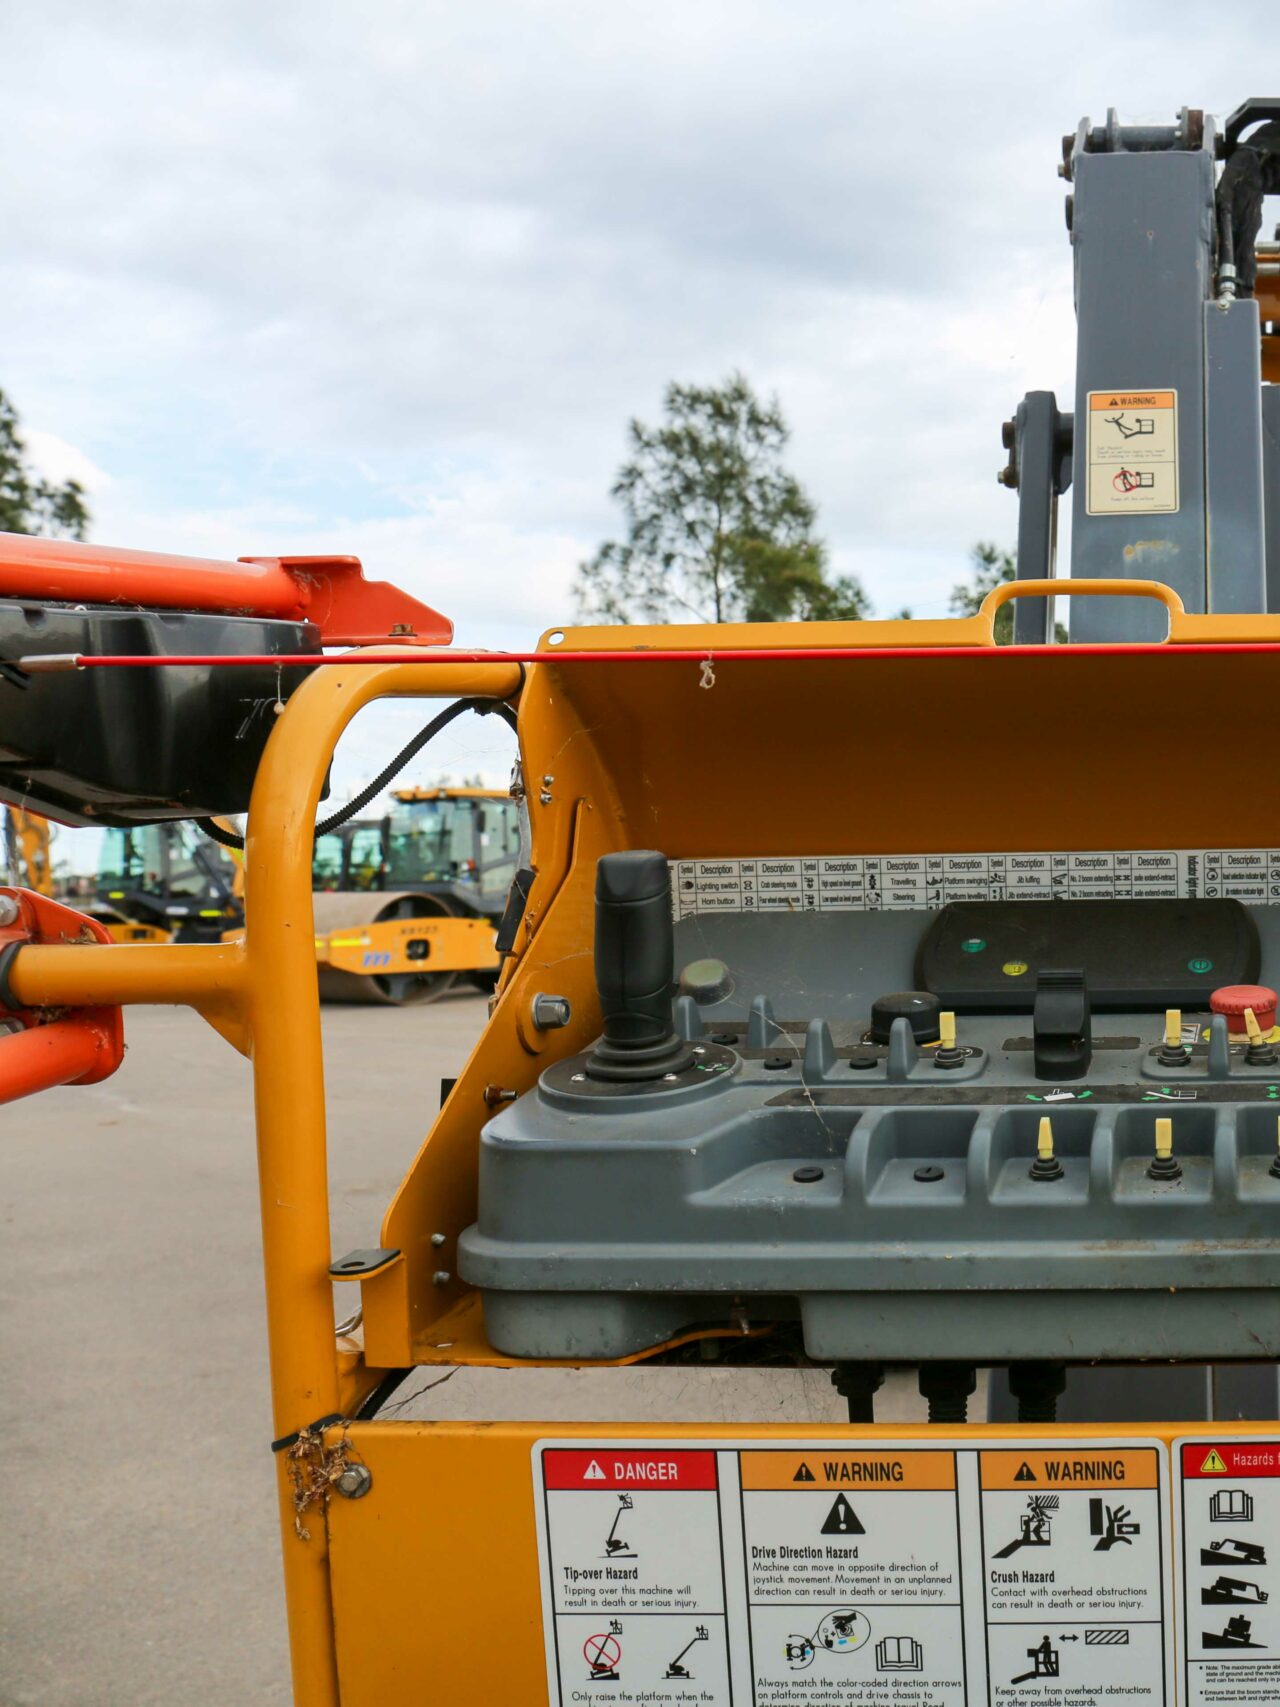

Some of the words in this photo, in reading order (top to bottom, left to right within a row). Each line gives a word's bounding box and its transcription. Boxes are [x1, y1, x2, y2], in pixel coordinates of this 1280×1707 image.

[1120, 397, 1156, 405] WARNING
[950, 860, 982, 869] Description
[1012, 858, 1044, 868] Description
[1075, 857, 1108, 867] Description
[1138, 857, 1170, 866] Description
[1228, 856, 1260, 865] Description
[701, 865, 732, 875] Description
[762, 864, 794, 874] Description
[825, 862, 857, 872] Description
[887, 861, 919, 871] Description
[697, 882, 719, 891] Lighting
[893, 893, 915, 902] Steering
[1233, 1453, 1274, 1465] Hazards
[614, 1463, 678, 1480] DANGER
[823, 1462, 903, 1481] WARNING
[1045, 1460, 1125, 1481] WARNING
[752, 1546, 776, 1558] Drive
[780, 1546, 822, 1558] Direction
[826, 1546, 858, 1558] Hazard
[753, 1562, 789, 1571] Machine
[838, 1563, 844, 1571] in
[848, 1562, 885, 1574] opposite
[889, 1562, 926, 1571] direction
[930, 1562, 939, 1571] of
[564, 1567, 602, 1582] Tip-over
[606, 1567, 638, 1580] Hazard
[991, 1571, 1018, 1583] Crush
[1022, 1571, 1055, 1583] Hazard
[753, 1575, 784, 1585] joystick
[835, 1575, 880, 1584] Movement
[884, 1575, 891, 1583] in
[909, 1575, 951, 1585] unplanned
[564, 1585, 595, 1596] Tipping
[622, 1585, 635, 1594] this
[639, 1585, 673, 1594] machine
[677, 1585, 691, 1594] will
[754, 1587, 791, 1596] direction
[813, 1587, 836, 1596] result
[840, 1587, 846, 1596] in
[850, 1587, 875, 1596] death
[891, 1587, 917, 1596] seriou
[921, 1587, 946, 1598] injury.
[991, 1587, 1026, 1596] Contact
[1030, 1587, 1048, 1596] with
[1052, 1586, 1092, 1596] overhead
[1096, 1587, 1147, 1596] obstructions
[565, 1598, 586, 1606] result
[602, 1598, 626, 1606] death
[642, 1598, 671, 1606] serious
[675, 1598, 699, 1608] injury.
[1011, 1600, 1033, 1608] result
[1037, 1600, 1044, 1608] in
[1048, 1599, 1072, 1608] death
[1089, 1599, 1115, 1608] seriou
[1119, 1599, 1144, 1609] injury.
[758, 1678, 788, 1688] Always
[792, 1678, 817, 1687] match
[820, 1678, 833, 1687] the
[837, 1678, 887, 1687] color-coded
[891, 1678, 928, 1687] direction
[771, 1690, 807, 1701] platform
[811, 1690, 844, 1699] controls
[847, 1690, 863, 1699] and
[866, 1689, 889, 1699] drive
[892, 1690, 921, 1699] chassis
[924, 1690, 933, 1699] to
[995, 1686, 1015, 1696] Keep
[1045, 1686, 1062, 1695] from
[1065, 1685, 1103, 1695] overhead
[1105, 1686, 1151, 1694] obstructions
[572, 1691, 592, 1703] Only
[620, 1691, 632, 1701] the
[636, 1692, 672, 1702] platform
[676, 1691, 697, 1701] when
[701, 1691, 714, 1701] the
[1007, 1698, 1027, 1707] other
[1031, 1698, 1062, 1707] possible
[1064, 1697, 1097, 1707] hazards.
